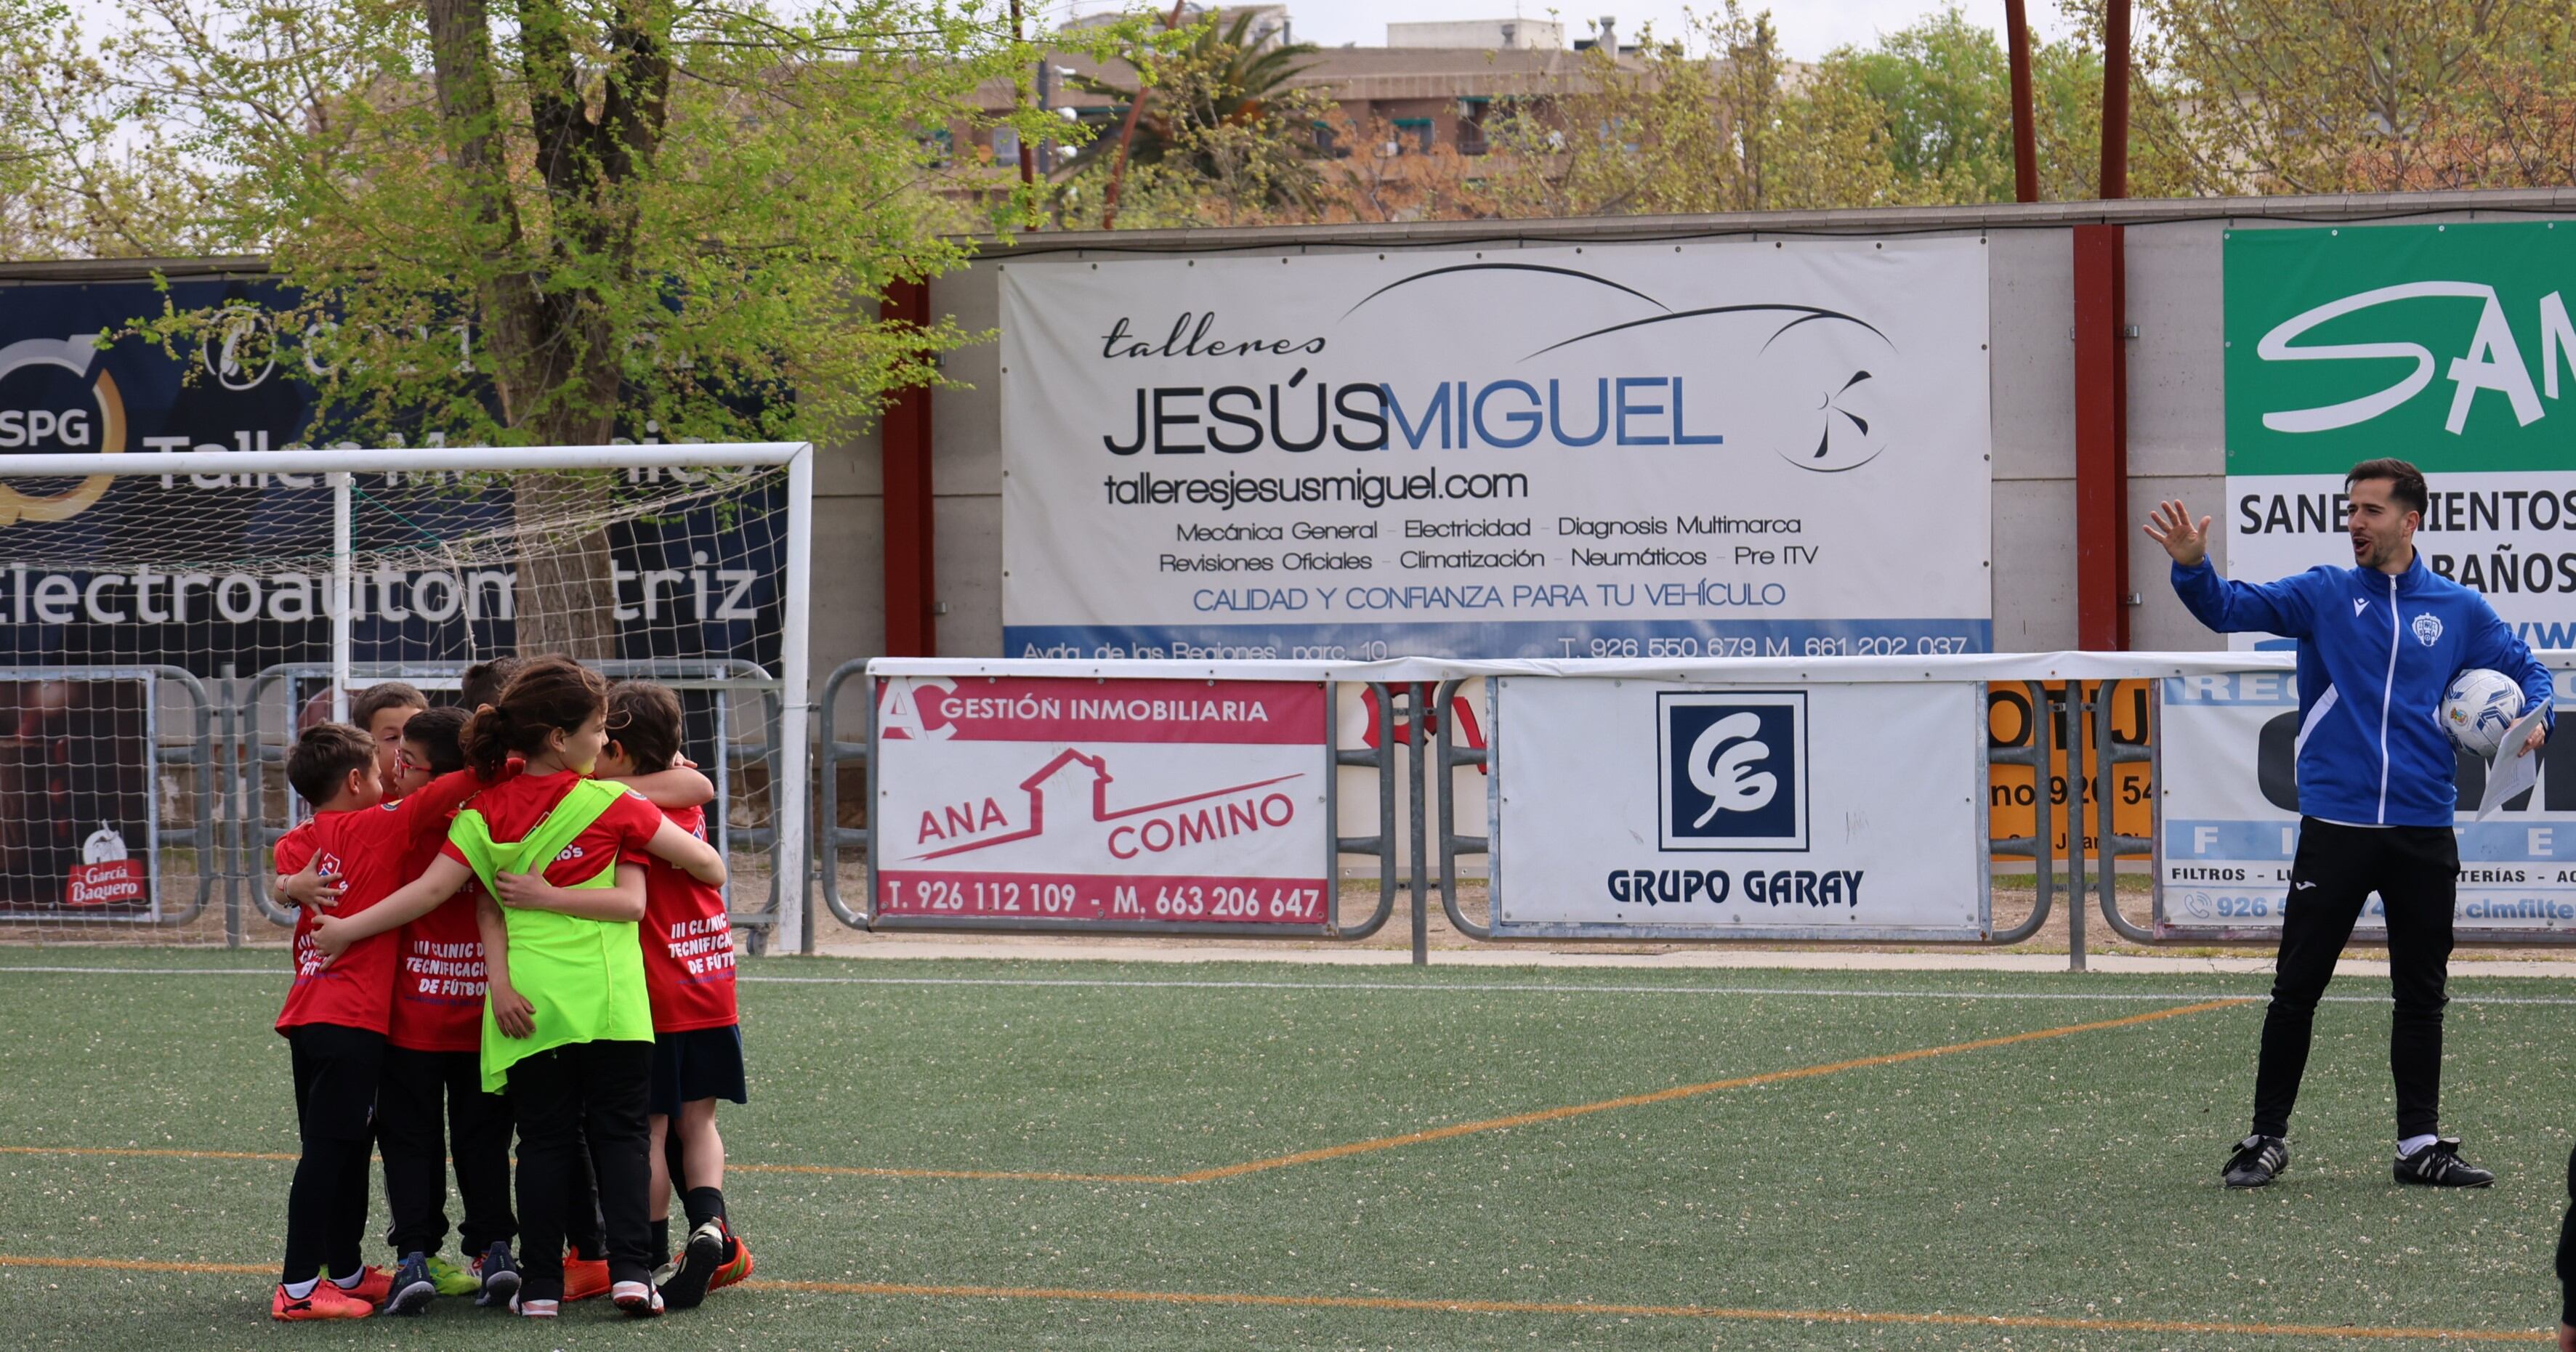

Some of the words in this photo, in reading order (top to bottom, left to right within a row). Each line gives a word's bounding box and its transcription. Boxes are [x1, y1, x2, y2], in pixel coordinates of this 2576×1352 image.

[1102, 311, 1326, 358] talleres
[0, 409, 89, 446] SPG
[1105, 465, 1527, 510] talleresjesusmiguel.com
[1176, 522, 1283, 542] Mecánica
[1292, 520, 1377, 539] General
[1405, 519, 1530, 538] Electricidad
[1559, 517, 1668, 539] Diagnosis
[1676, 515, 1801, 535] Multimarca
[1160, 554, 1273, 572] Revisiones
[1283, 551, 1372, 571] Oficiales
[1400, 549, 1545, 569] Climatización
[1571, 547, 1707, 567] Neumáticos
[1735, 546, 1774, 565] Pre
[1783, 545, 1819, 564] ITV
[1193, 588, 1307, 611] CALIDAD
[1316, 586, 1337, 610] Y
[1346, 586, 1503, 610] CONFIANZA
[1514, 583, 1588, 608] PARA
[1596, 583, 1634, 607] TU
[1645, 578, 1785, 607] VEHÍCULO
[1360, 640, 1387, 660] 10
[1591, 637, 1638, 657] 926
[1648, 637, 1697, 657] 550
[1708, 637, 1756, 657] 679
[1806, 636, 1846, 656] 661
[1858, 636, 1907, 655] 202
[1918, 636, 1967, 655] 037
[940, 694, 1060, 719] GESTIÓN
[1071, 699, 1268, 721] INMOBILIARIA
[918, 797, 1009, 844] ANA
[1108, 793, 1294, 859] COMINO
[86, 867, 127, 884] García
[2172, 868, 2245, 881] FILTROS
[72, 881, 138, 903] Baquero
[889, 881, 908, 908] T.
[918, 881, 963, 910] 926
[974, 882, 1020, 911] 112
[1030, 883, 1075, 912] 109
[1113, 886, 1145, 914] M.
[1155, 886, 1203, 915] 663
[1212, 887, 1259, 916] 206
[1270, 888, 1319, 918] 647
[1607, 870, 1730, 907] GRUPO
[1744, 870, 1864, 907] GARAY
[2217, 896, 2268, 918] 926
[2466, 898, 2576, 919] clmfilte
[689, 912, 727, 935] CLINIC
[432, 942, 474, 958] CLINIC
[687, 958, 703, 975] DE
[706, 952, 735, 971] FÚTB
[419, 978, 440, 994] DE
